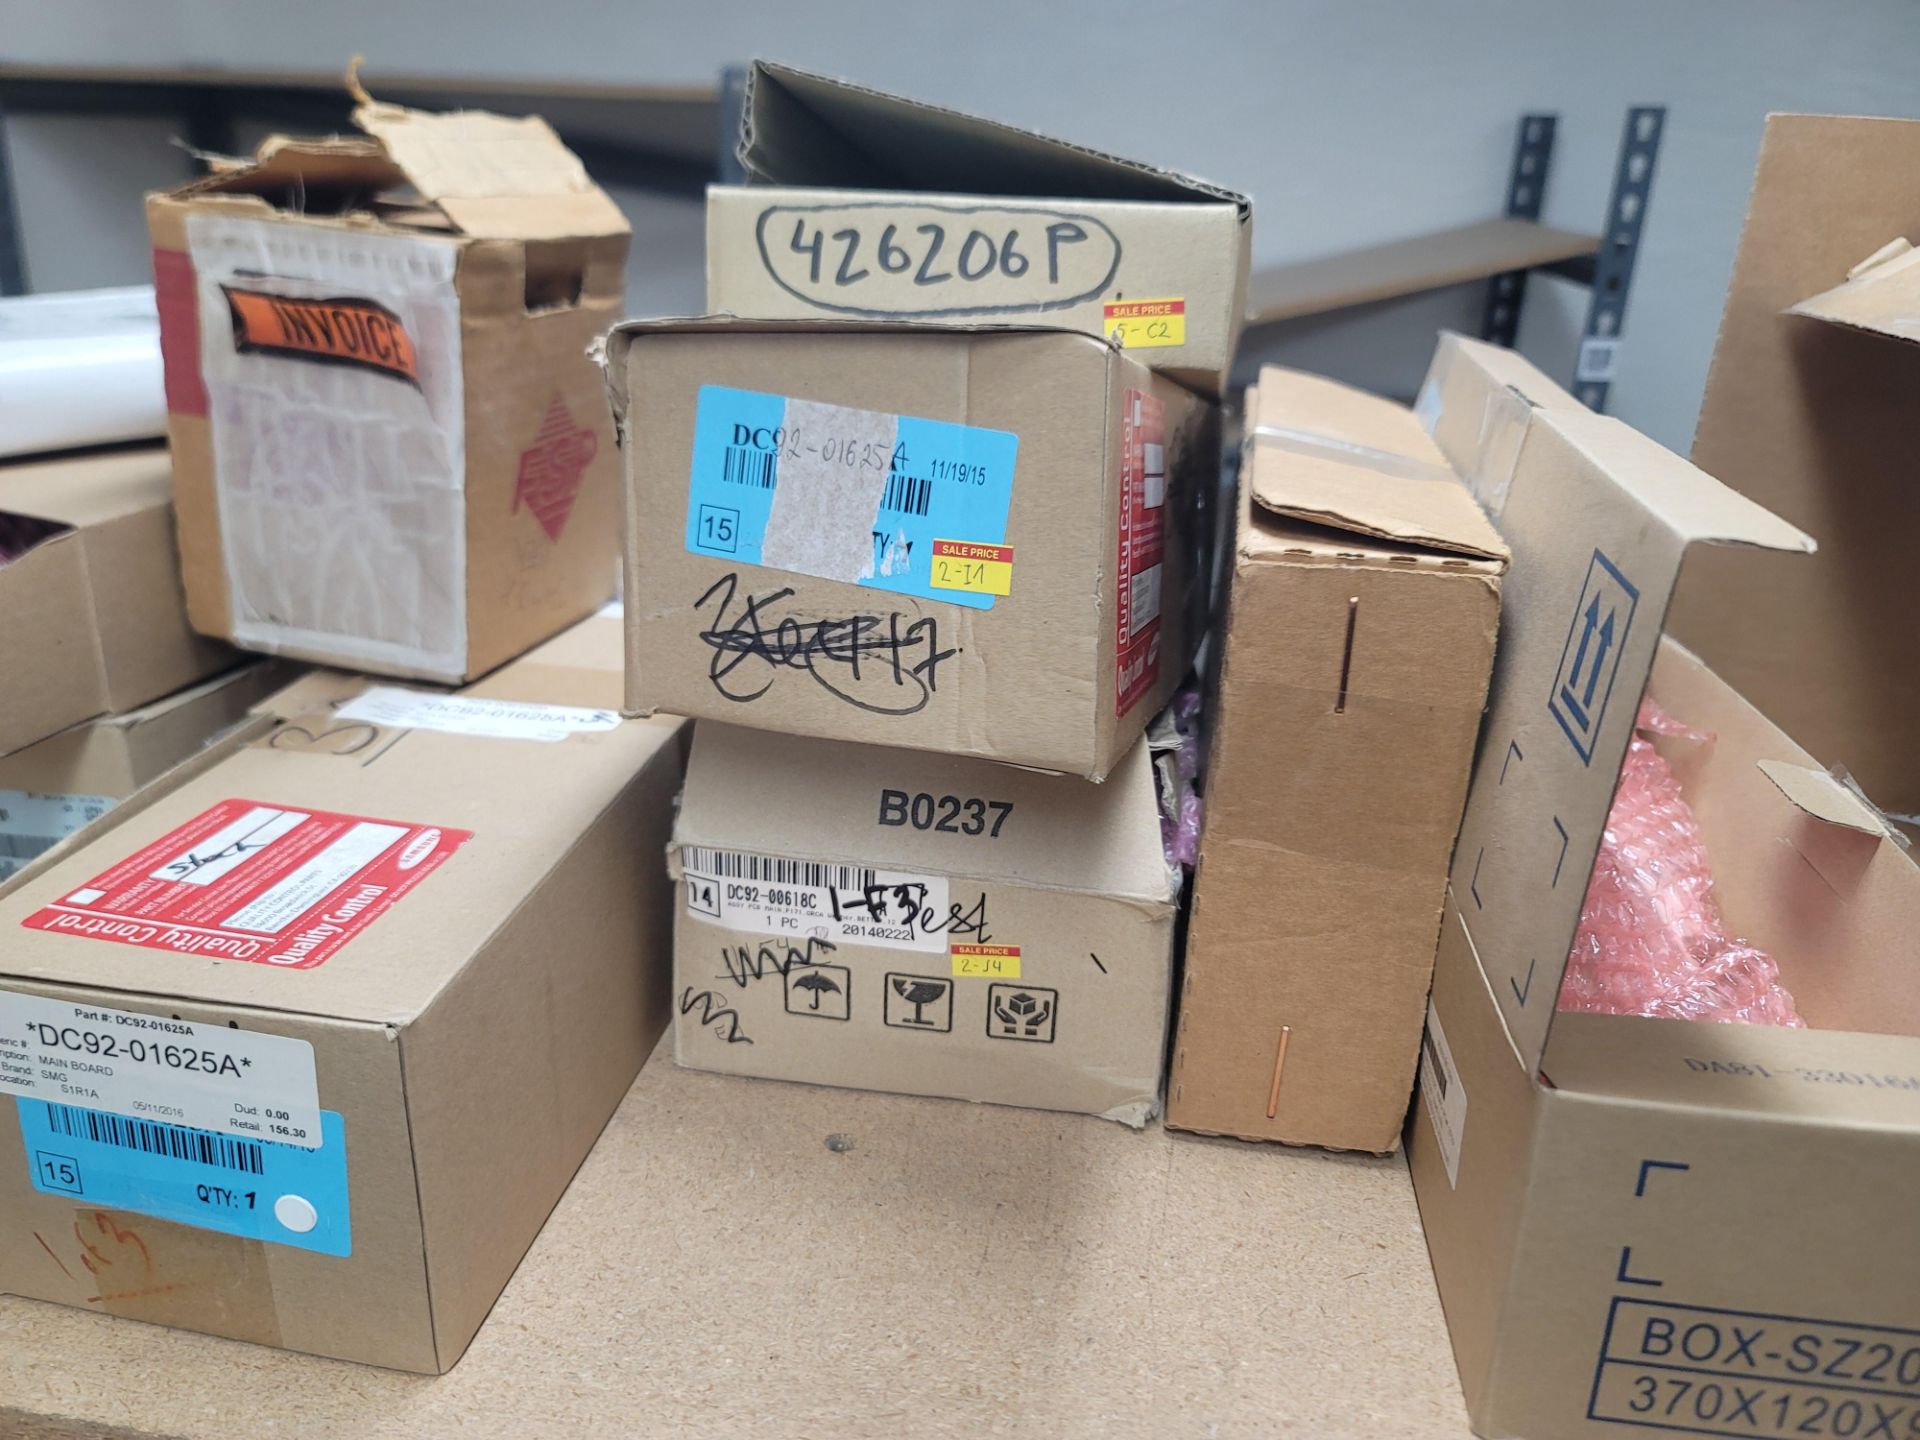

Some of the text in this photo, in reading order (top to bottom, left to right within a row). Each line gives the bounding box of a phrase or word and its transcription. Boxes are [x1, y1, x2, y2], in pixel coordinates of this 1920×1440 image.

[790, 218, 1088, 286] 426206P
[1113, 304, 1171, 317] SALE PRICE
[273, 300, 408, 366] INVOICE
[931, 458, 986, 487] 11/19/15
[704, 515, 732, 542] 15
[1118, 417, 1131, 645] Quality Control
[942, 544, 1000, 560] SALE PRICE
[878, 789, 1014, 838] B0237
[727, 883, 817, 909] DC92-00618C
[268, 920, 345, 966] Quality
[323, 884, 390, 925] Control
[766, 915, 799, 929] 1 PC
[842, 924, 911, 941] 20140222
[44, 912, 260, 959] Quality Control
[959, 946, 1009, 956] SALE PRICE
[75, 1007, 99, 1021] Part
[116, 1015, 194, 1037] DC92-01625A
[1, 1062, 68, 1083] Brand: SMG
[39, 1055, 68, 1068] MAIN
[71, 1061, 114, 1077] BOARD
[60, 1084, 99, 1099] S1R1A
[234, 1103, 290, 1121] Dud: 0.00
[230, 1118, 262, 1132] Retail:
[269, 1124, 306, 1139] 156.30
[44, 1161, 76, 1185] 15
[196, 1184, 257, 1210] Q'TY: 1
